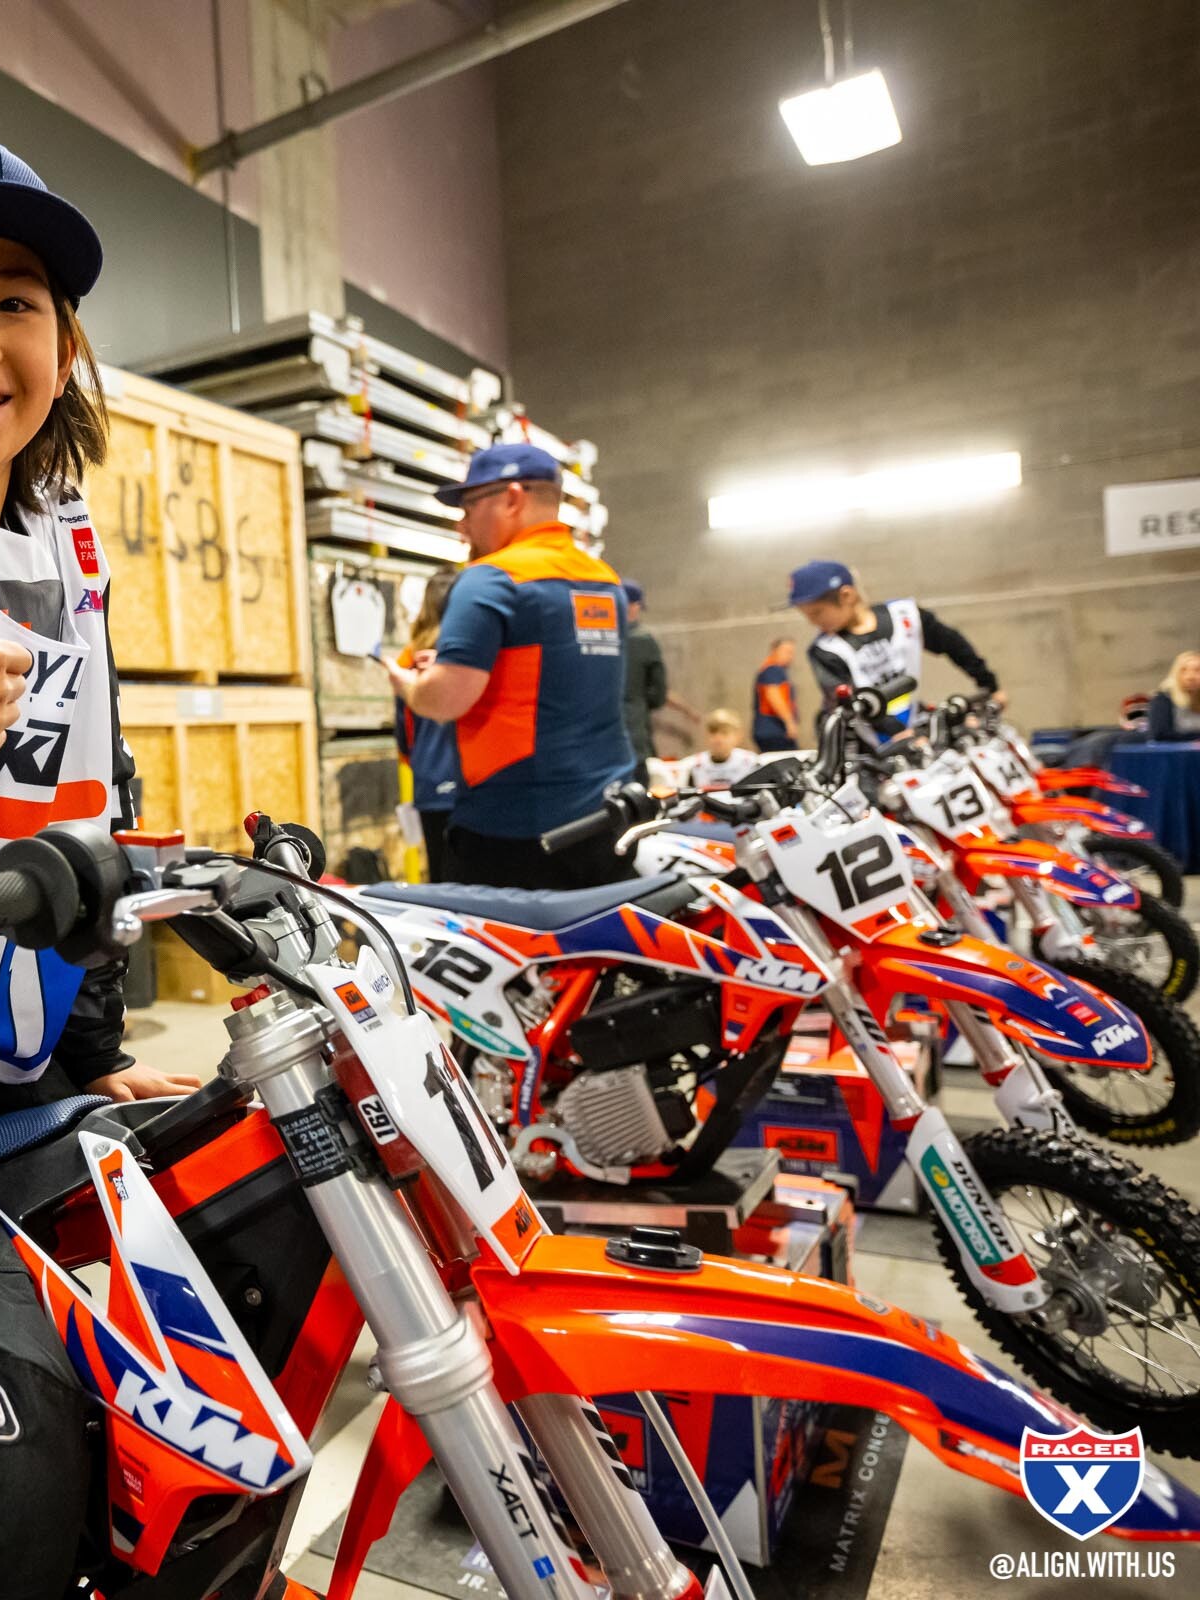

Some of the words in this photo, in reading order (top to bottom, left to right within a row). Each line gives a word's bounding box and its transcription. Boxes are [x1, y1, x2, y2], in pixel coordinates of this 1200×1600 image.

[934, 783, 984, 828] 13
[816, 834, 905, 912] 12
[411, 937, 494, 999] 12
[734, 958, 822, 992] KTM
[1091, 1024, 1139, 1057] KTM
[940, 1186, 994, 1262] MOTOREX
[951, 1159, 1014, 1254] DUNLOP
[113, 1368, 278, 1487] KTM
[488, 1463, 540, 1540] XACT
[829, 1488, 867, 1572] MATRIX
